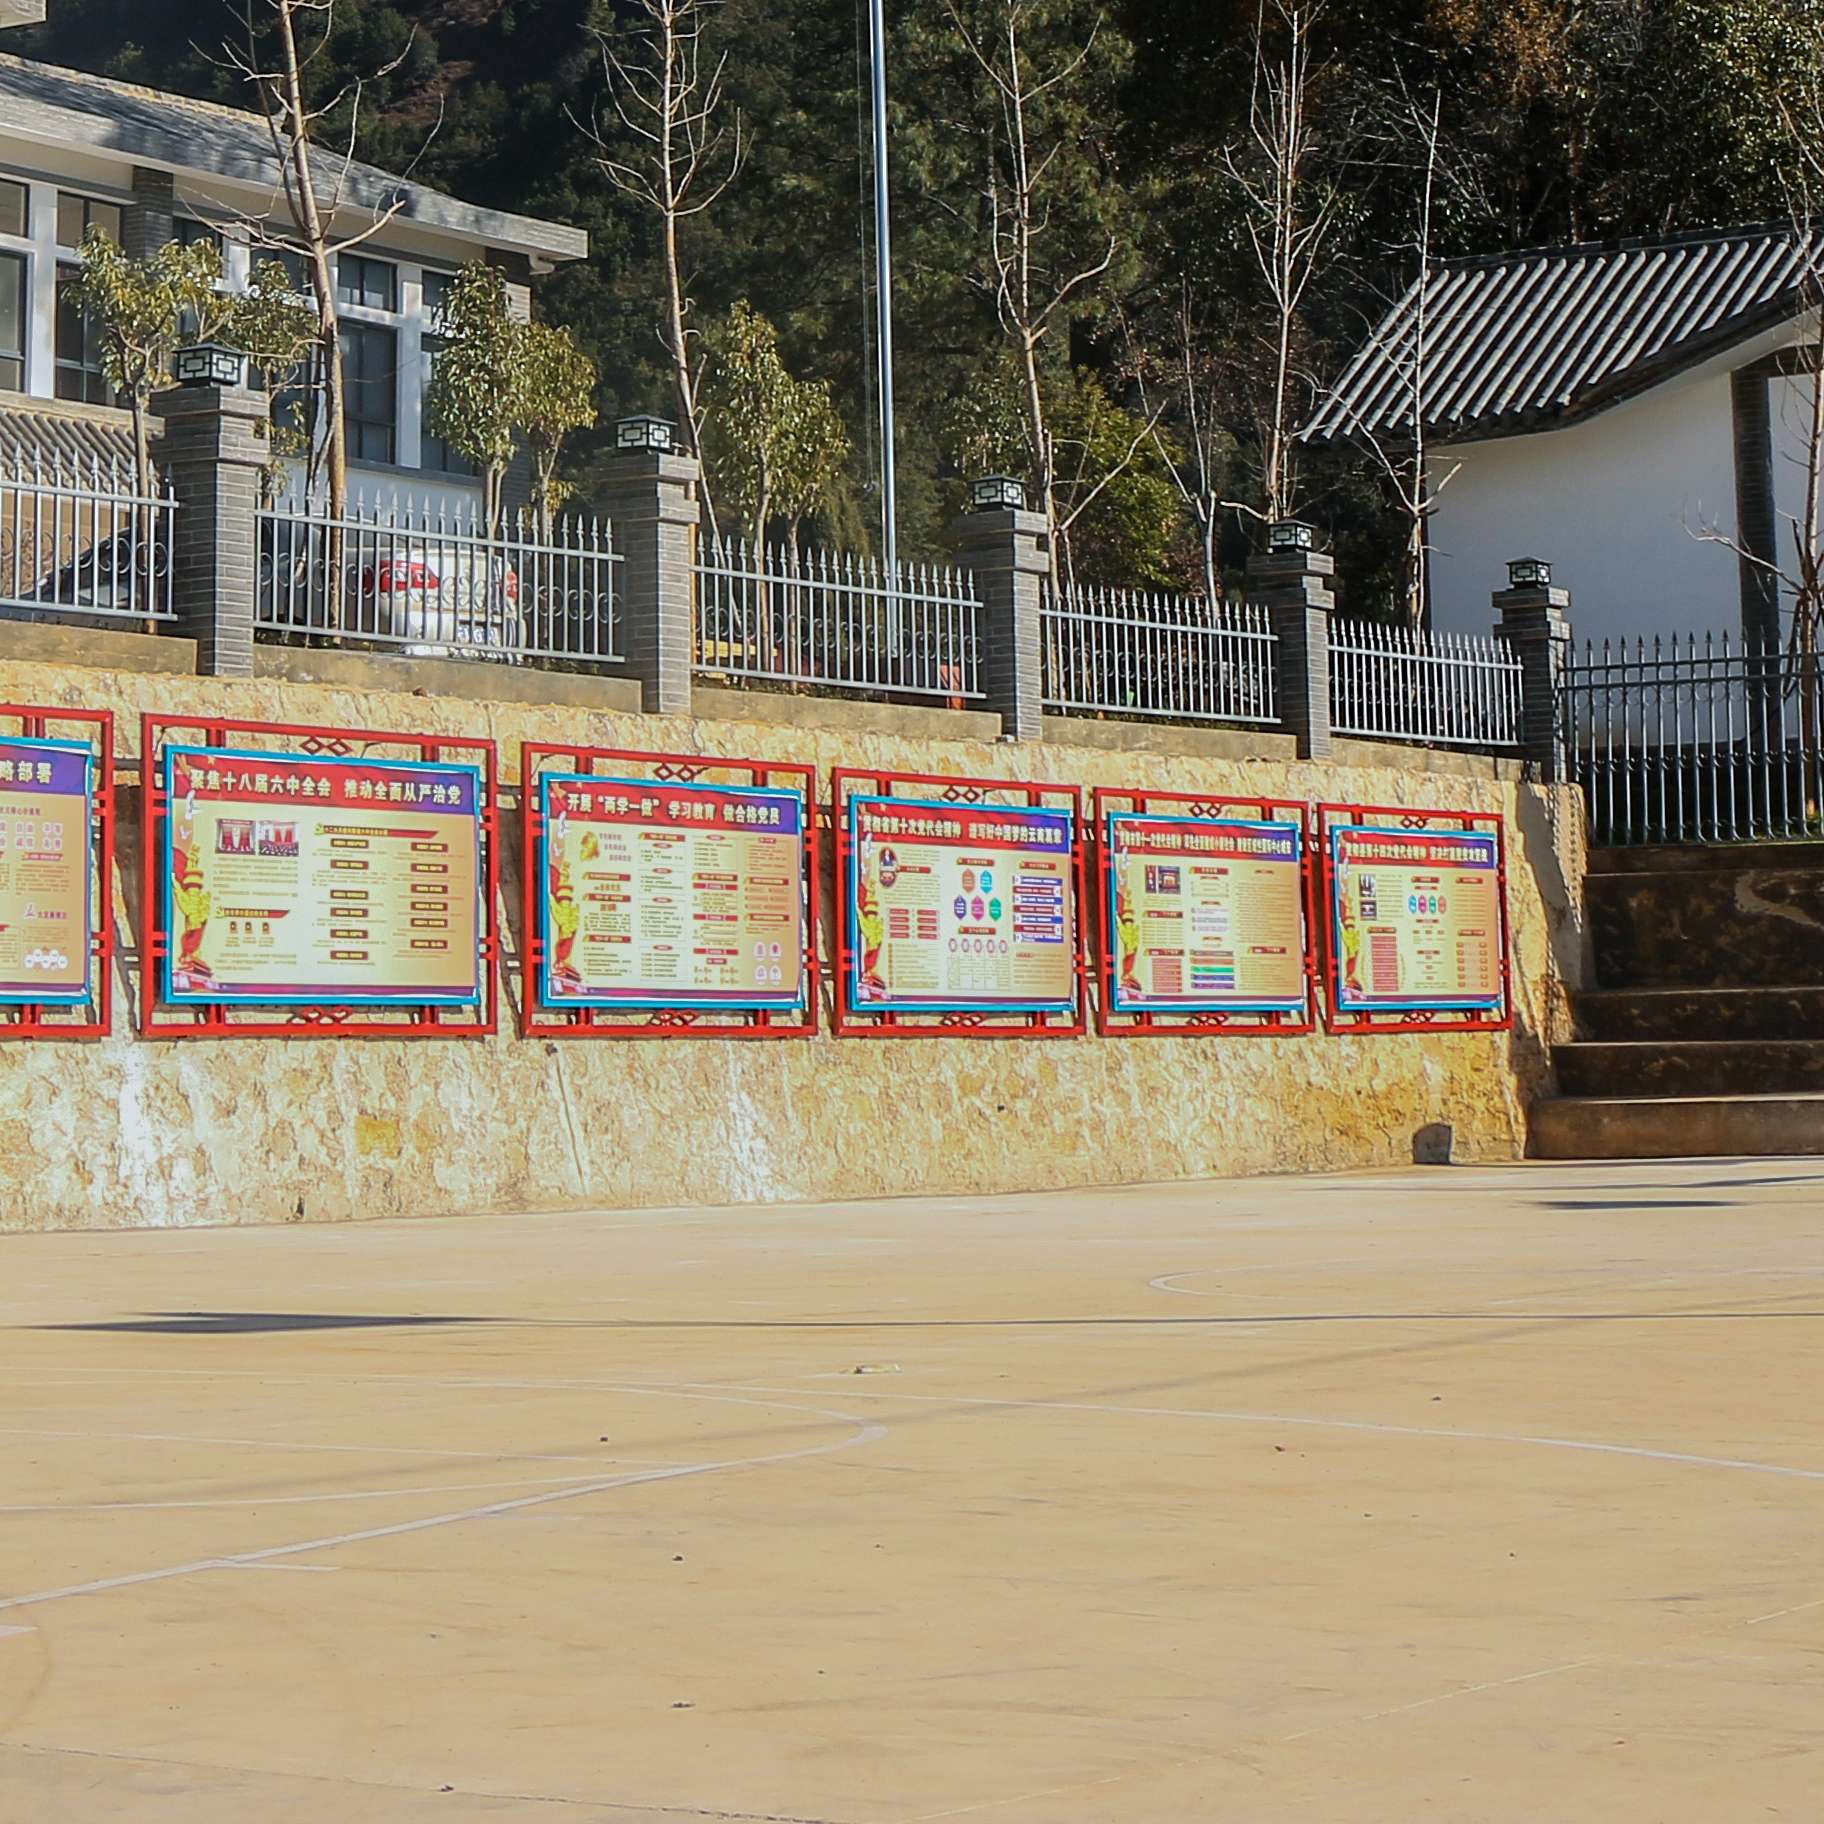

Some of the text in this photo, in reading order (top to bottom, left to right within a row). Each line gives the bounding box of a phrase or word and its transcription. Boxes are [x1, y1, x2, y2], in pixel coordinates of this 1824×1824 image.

[190, 769, 463, 806] 聚焦十八届六中全会 推动全面从严治党
